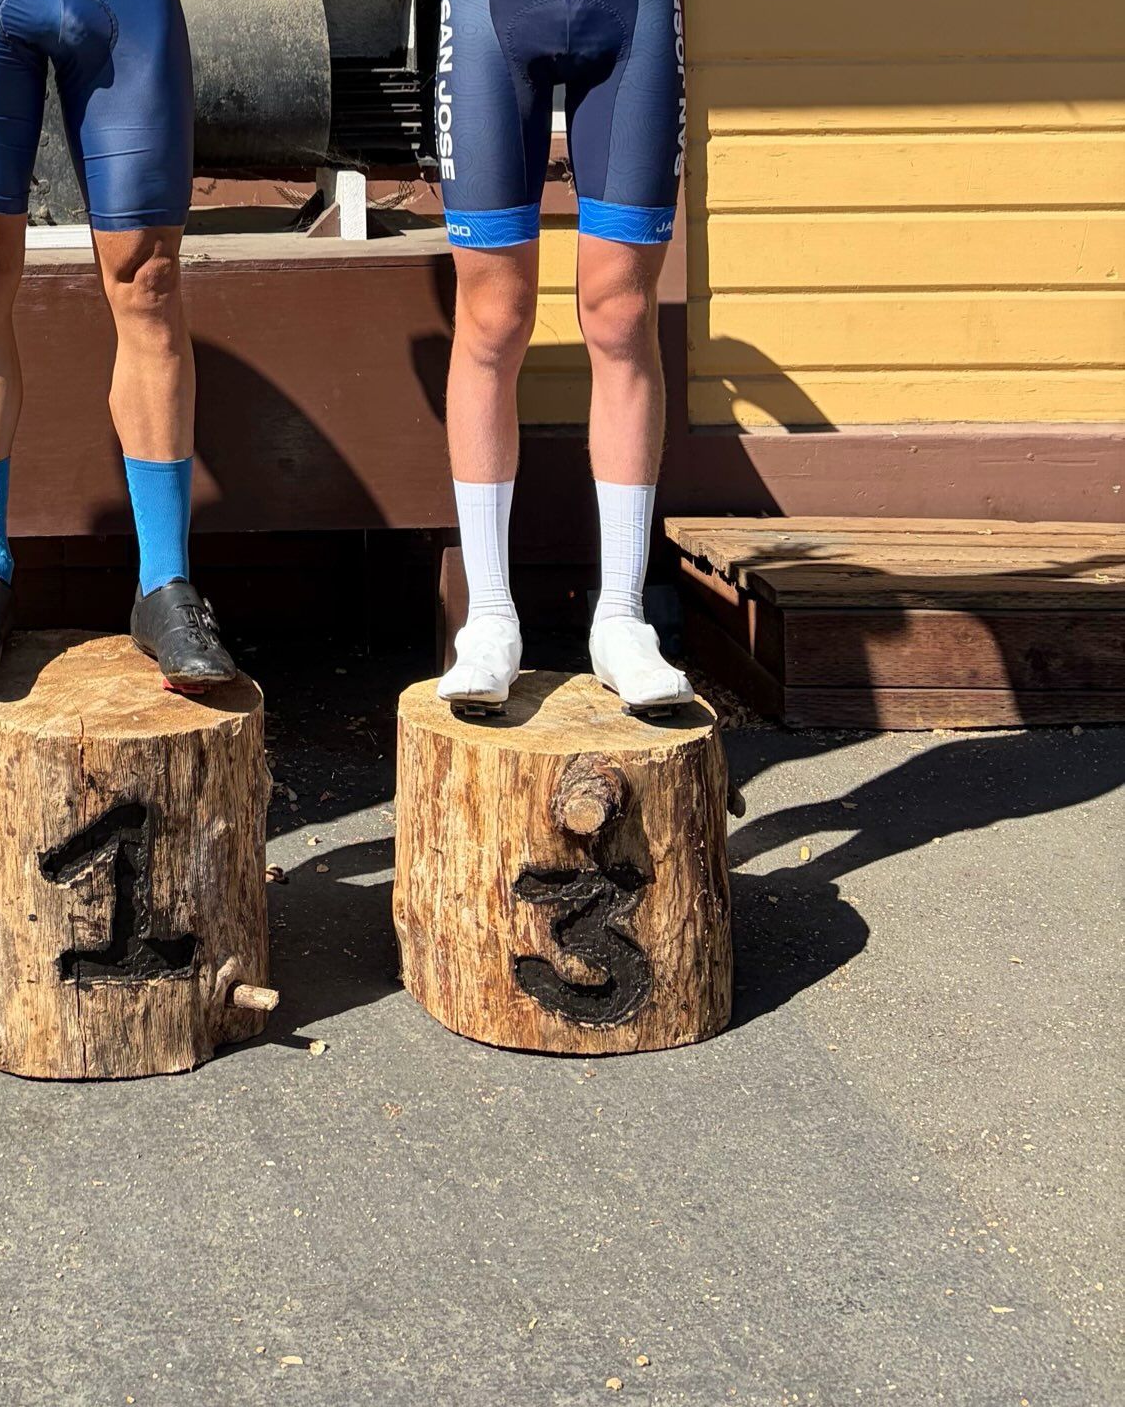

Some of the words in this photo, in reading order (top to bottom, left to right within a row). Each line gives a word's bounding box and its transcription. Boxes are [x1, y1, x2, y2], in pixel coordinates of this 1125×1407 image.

[437, 80, 455, 181] JOSE
[37, 803, 200, 984] 1
[512, 861, 655, 1029] 3
